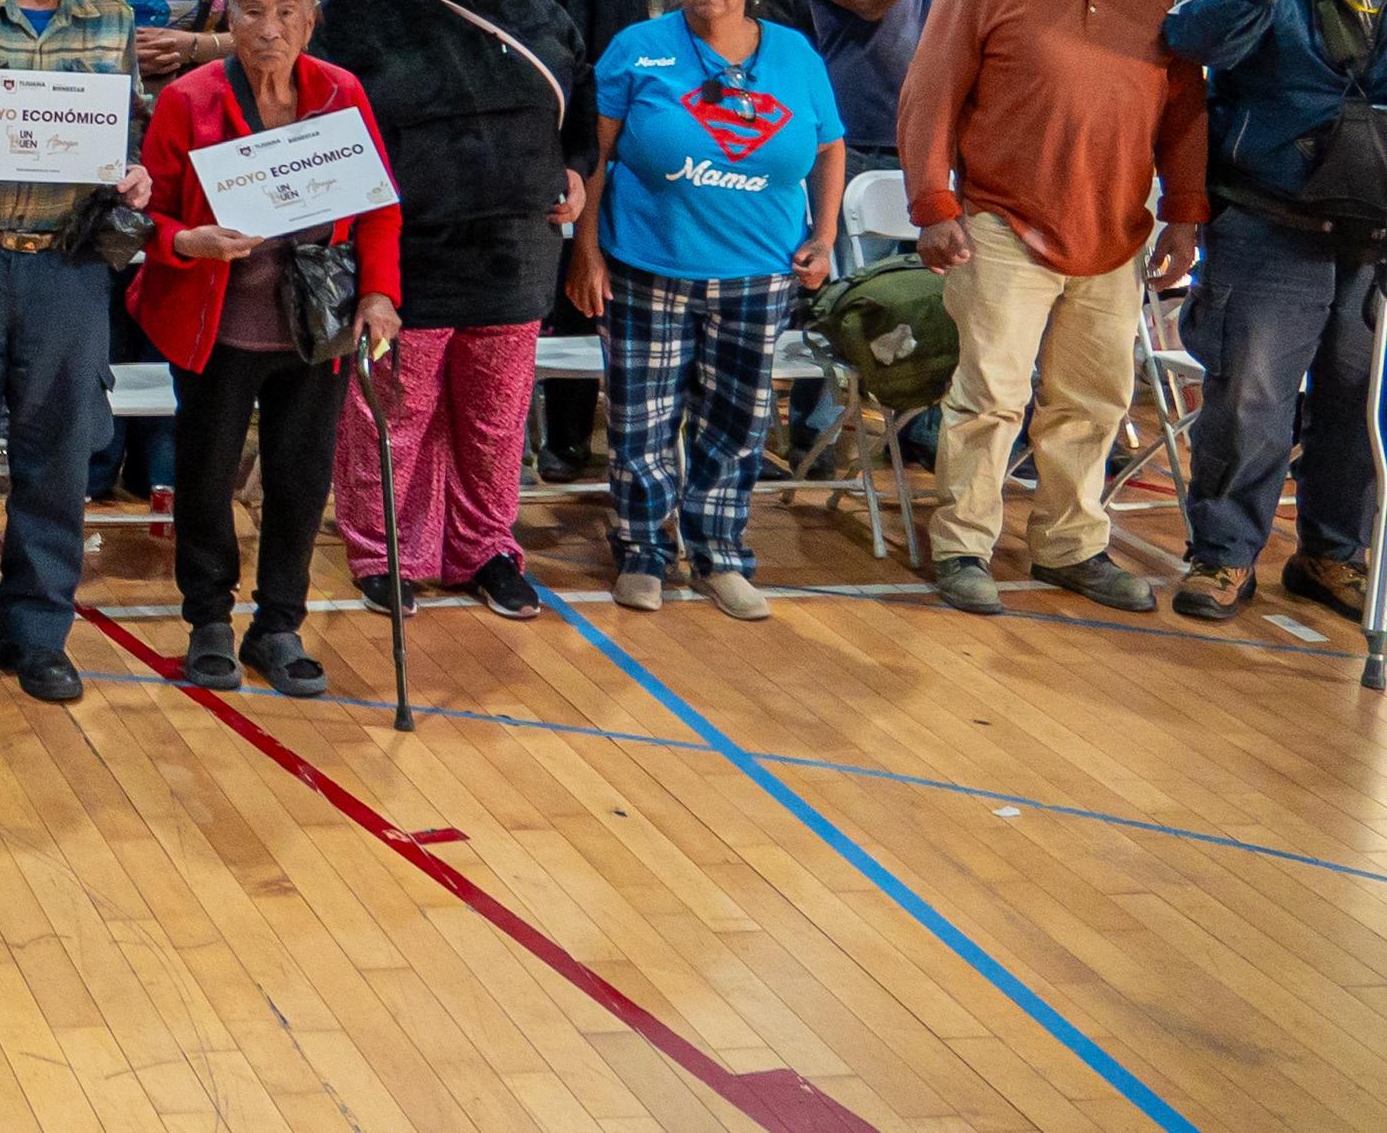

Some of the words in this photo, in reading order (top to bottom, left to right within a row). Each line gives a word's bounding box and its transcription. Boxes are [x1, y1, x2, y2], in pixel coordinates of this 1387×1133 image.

[22, 109, 118, 126] ECONÓMICO
[19, 130, 33, 139] UN
[216, 169, 267, 193] APOYO
[269, 143, 365, 178] ECONÓMICO
[665, 156, 770, 192] Mamá
[276, 182, 292, 194] UN
